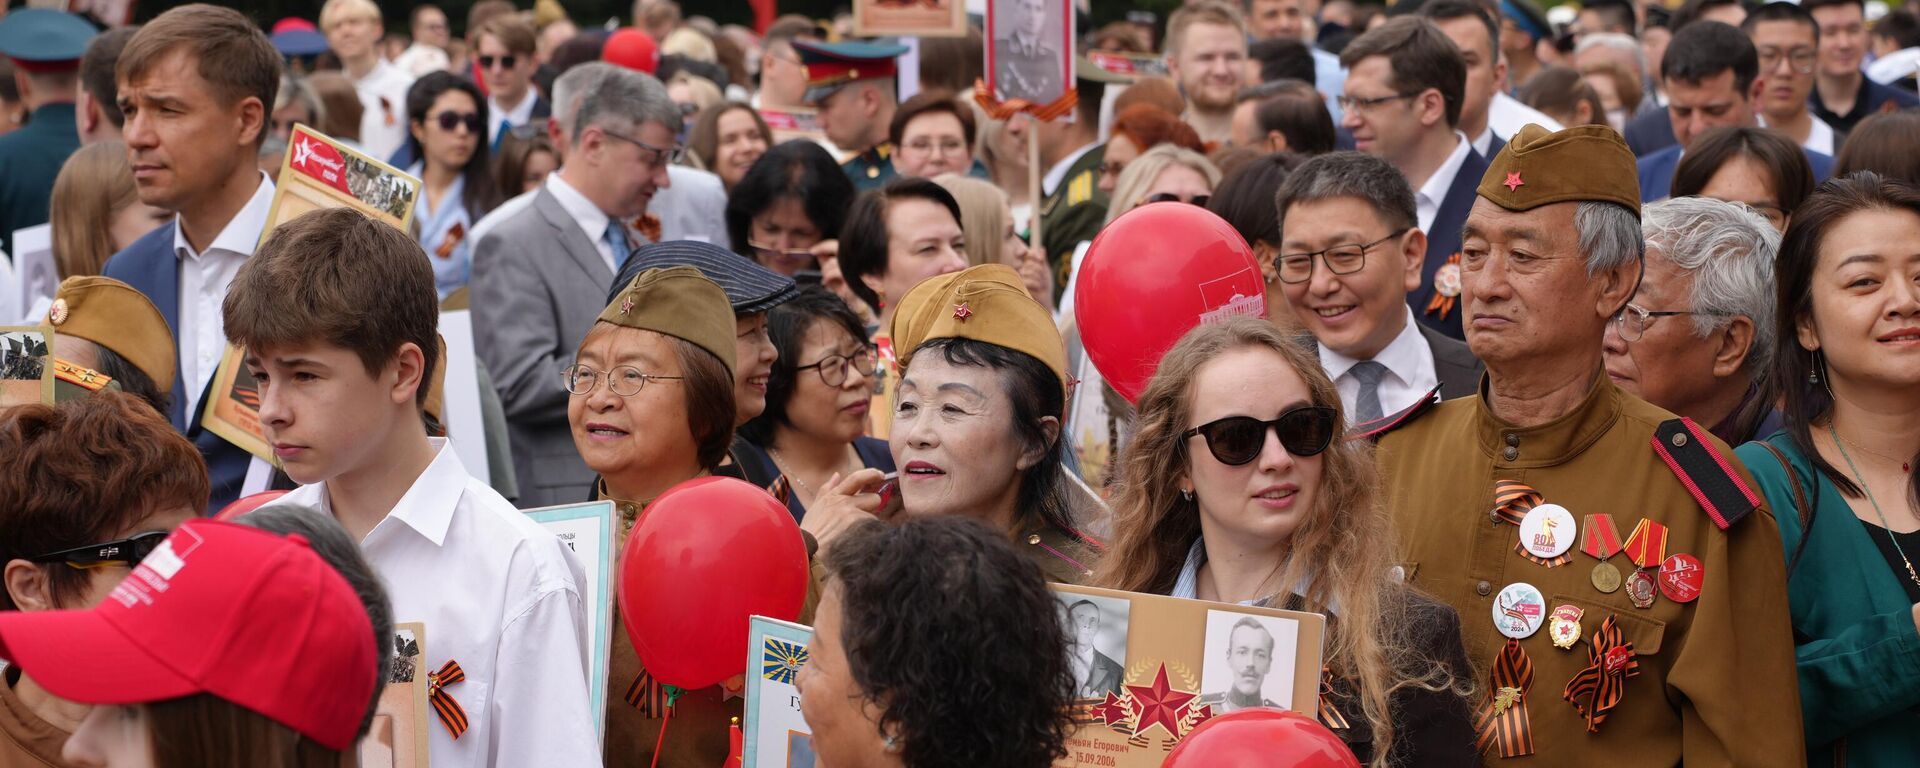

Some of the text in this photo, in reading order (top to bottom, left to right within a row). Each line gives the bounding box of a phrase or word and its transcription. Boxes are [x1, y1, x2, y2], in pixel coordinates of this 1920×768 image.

[1534, 533, 1546, 545] 80
[1606, 655, 1615, 670] 9
[1093, 738, 1129, 753] Егорович
[1076, 751, 1116, 767] 15.09.2006
